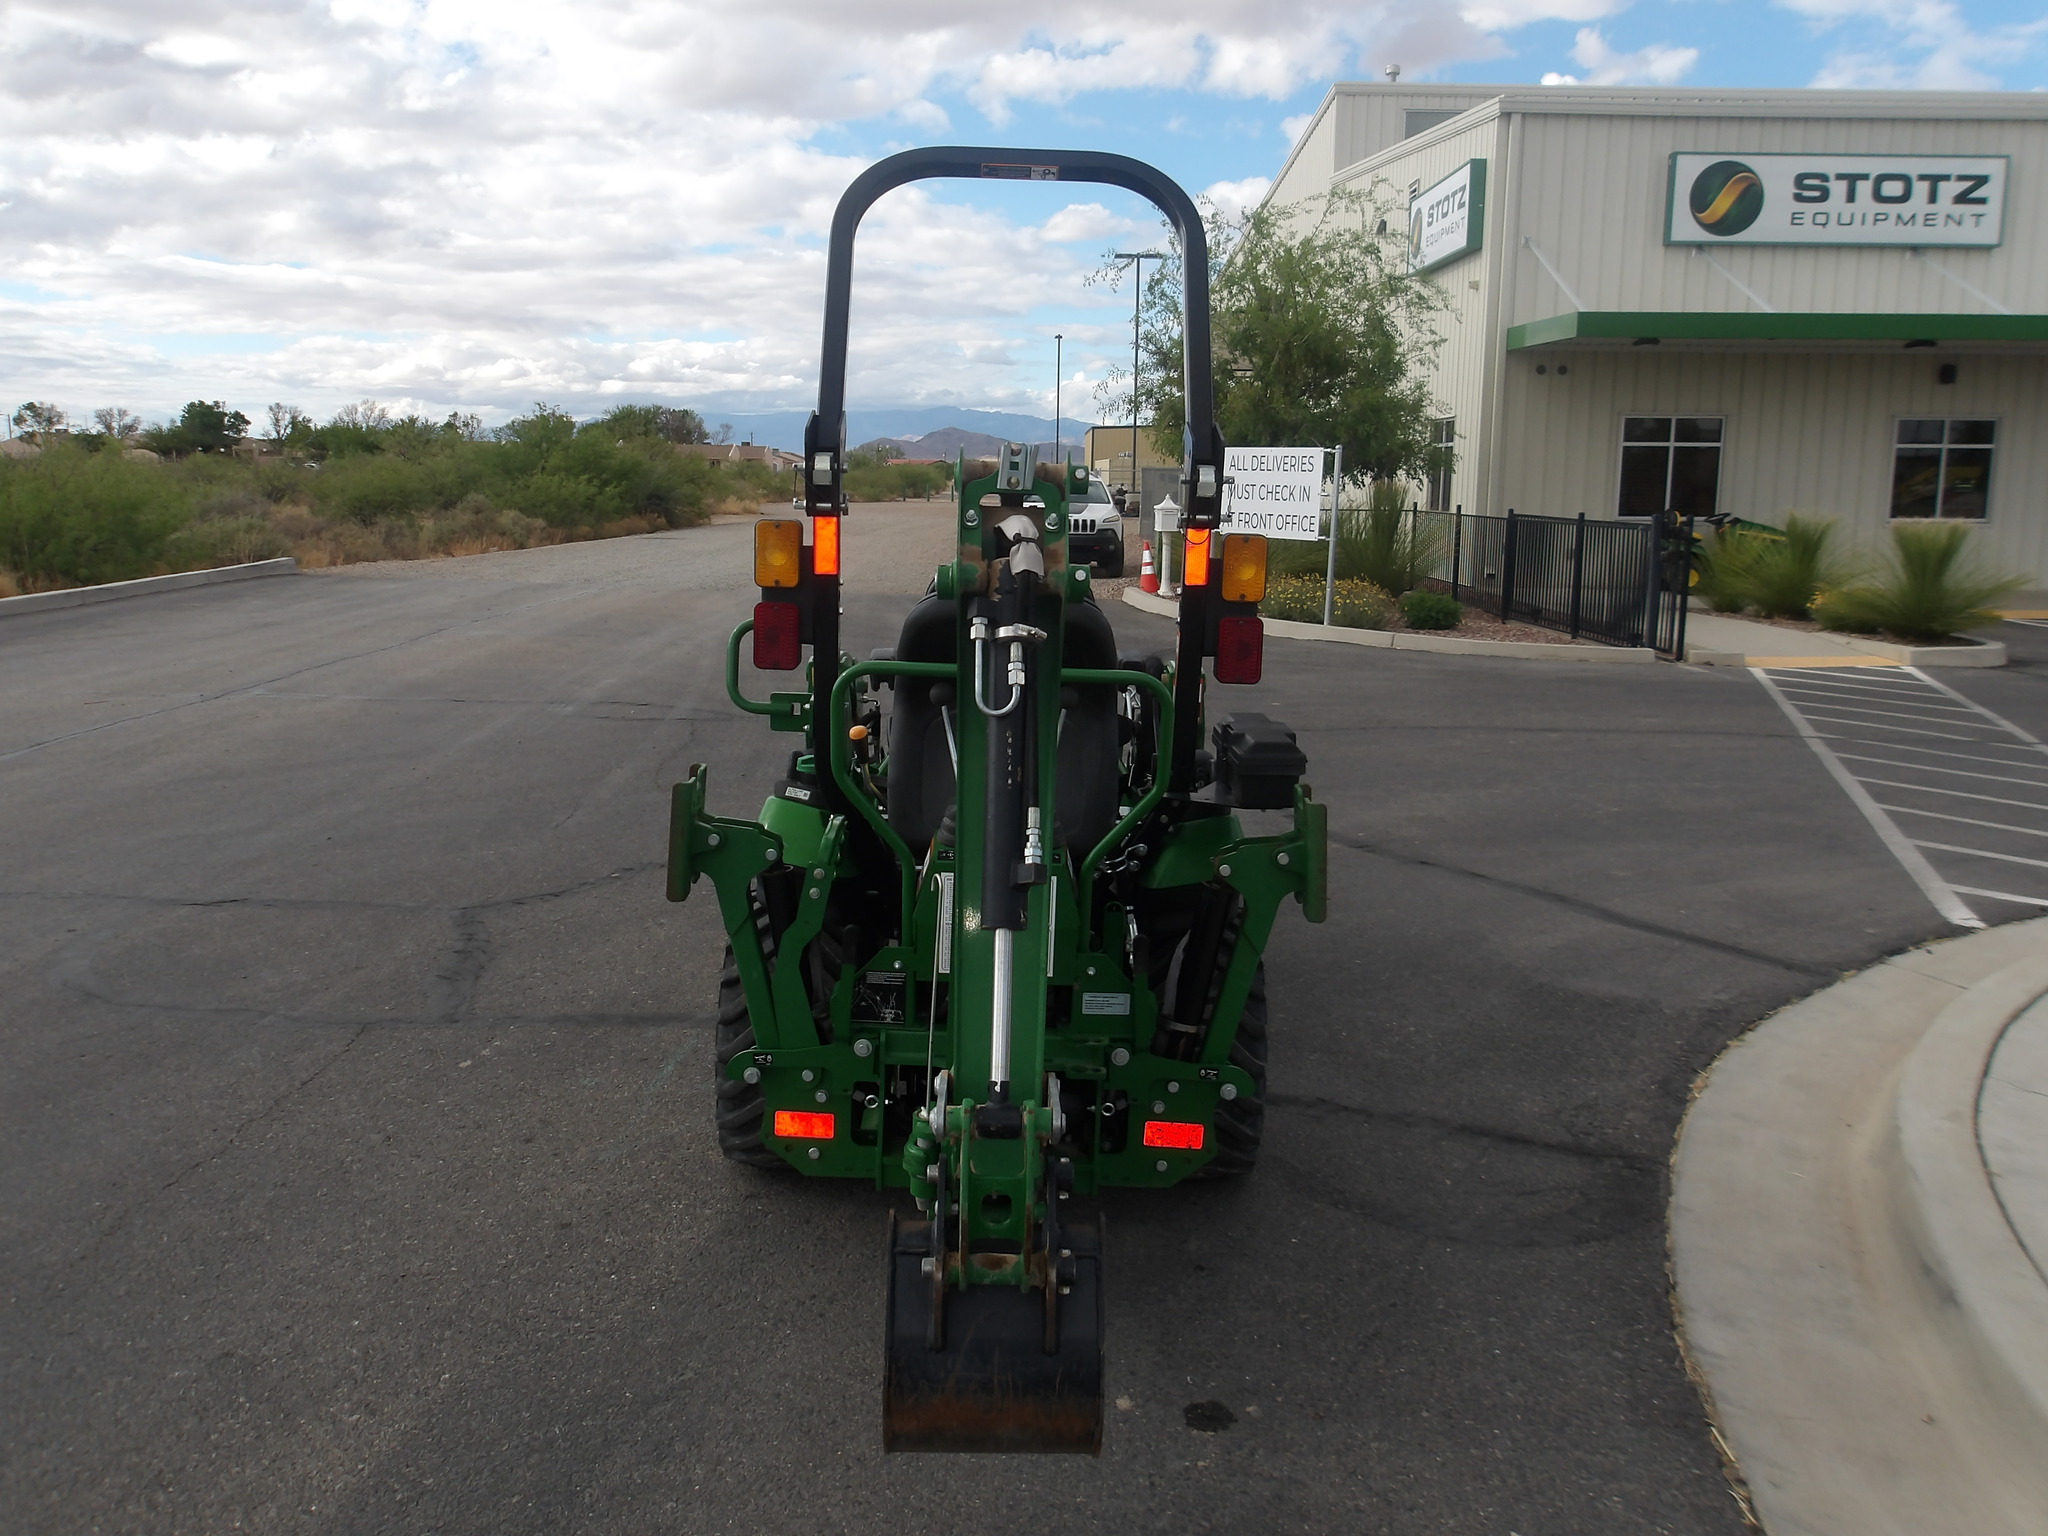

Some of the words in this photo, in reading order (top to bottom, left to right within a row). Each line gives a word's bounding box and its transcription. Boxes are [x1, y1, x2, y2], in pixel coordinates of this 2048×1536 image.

[1791, 171, 1991, 205] STOTZ
[1426, 183, 1467, 228] STOTZ
[1790, 211, 1988, 229] EQUIPMENT
[1425, 216, 1466, 248] EQUIPMENT
[1229, 455, 1248, 471] ALL
[1251, 455, 1315, 473] DELIVERIES
[1227, 483, 1256, 500] MUST
[1258, 484, 1296, 502] CHECK
[1299, 485, 1311, 502] IN
[1238, 512, 1273, 530] FRONT
[1275, 514, 1316, 532] OFFICE
